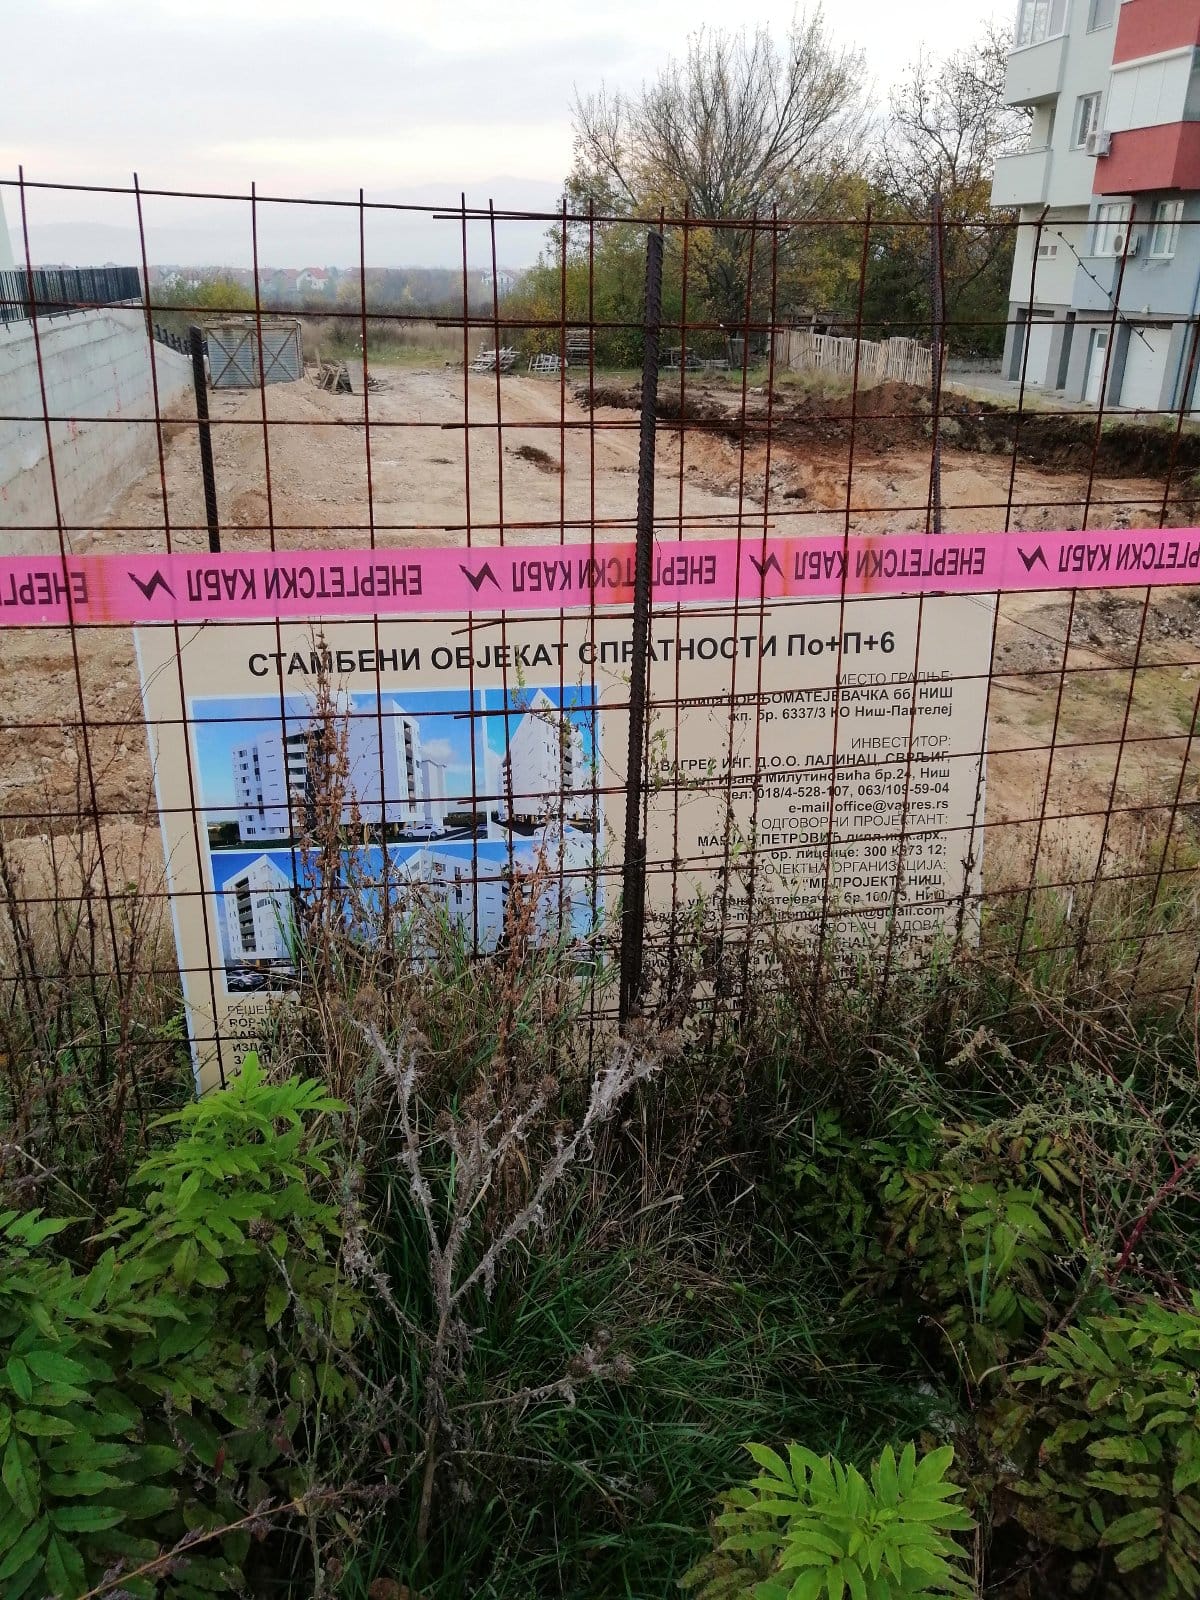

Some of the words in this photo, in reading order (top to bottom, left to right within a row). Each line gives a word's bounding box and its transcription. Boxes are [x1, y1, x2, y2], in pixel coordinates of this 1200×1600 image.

[794, 550, 848, 580] КАБЛ
[855, 547, 986, 578] ЕНЕРГЕТСКИ
[1058, 543, 1112, 572] КАБЛ
[512, 559, 572, 592] КАБЛ
[579, 554, 717, 590] ЕНЕРГТСКИ
[0, 571, 88, 606] ЕНЕРГ
[186, 568, 257, 602] КАБЛ
[265, 564, 422, 599] ЕНЕРГЕТСКИ
[248, 647, 421, 677] СТАМБЕНИ
[431, 642, 569, 670] ОБЈЕКАТ
[787, 631, 896, 657] По+П+6
[838, 672, 887, 686] МЕСТО
[919, 686, 953, 699] НИШ
[759, 709, 778, 722] бр.
[782, 706, 826, 719] 6337/3
[830, 706, 851, 718] КО
[851, 735, 951, 749] ИНВЕСТИТОР:
[722, 756, 752, 769] ИНГ.
[757, 754, 800, 770] Д.О.О.
[765, 769, 870, 785] Милутиновића
[920, 767, 950, 778] Ниш
[728, 789, 753, 800] ел:
[857, 782, 950, 796] 063/109-59-04
[761, 815, 849, 832] ОДГОВОРНИ
[771, 849, 791, 862] бр.
[864, 845, 887, 857] 300
[751, 861, 827, 876] РОЈЕКТНА
